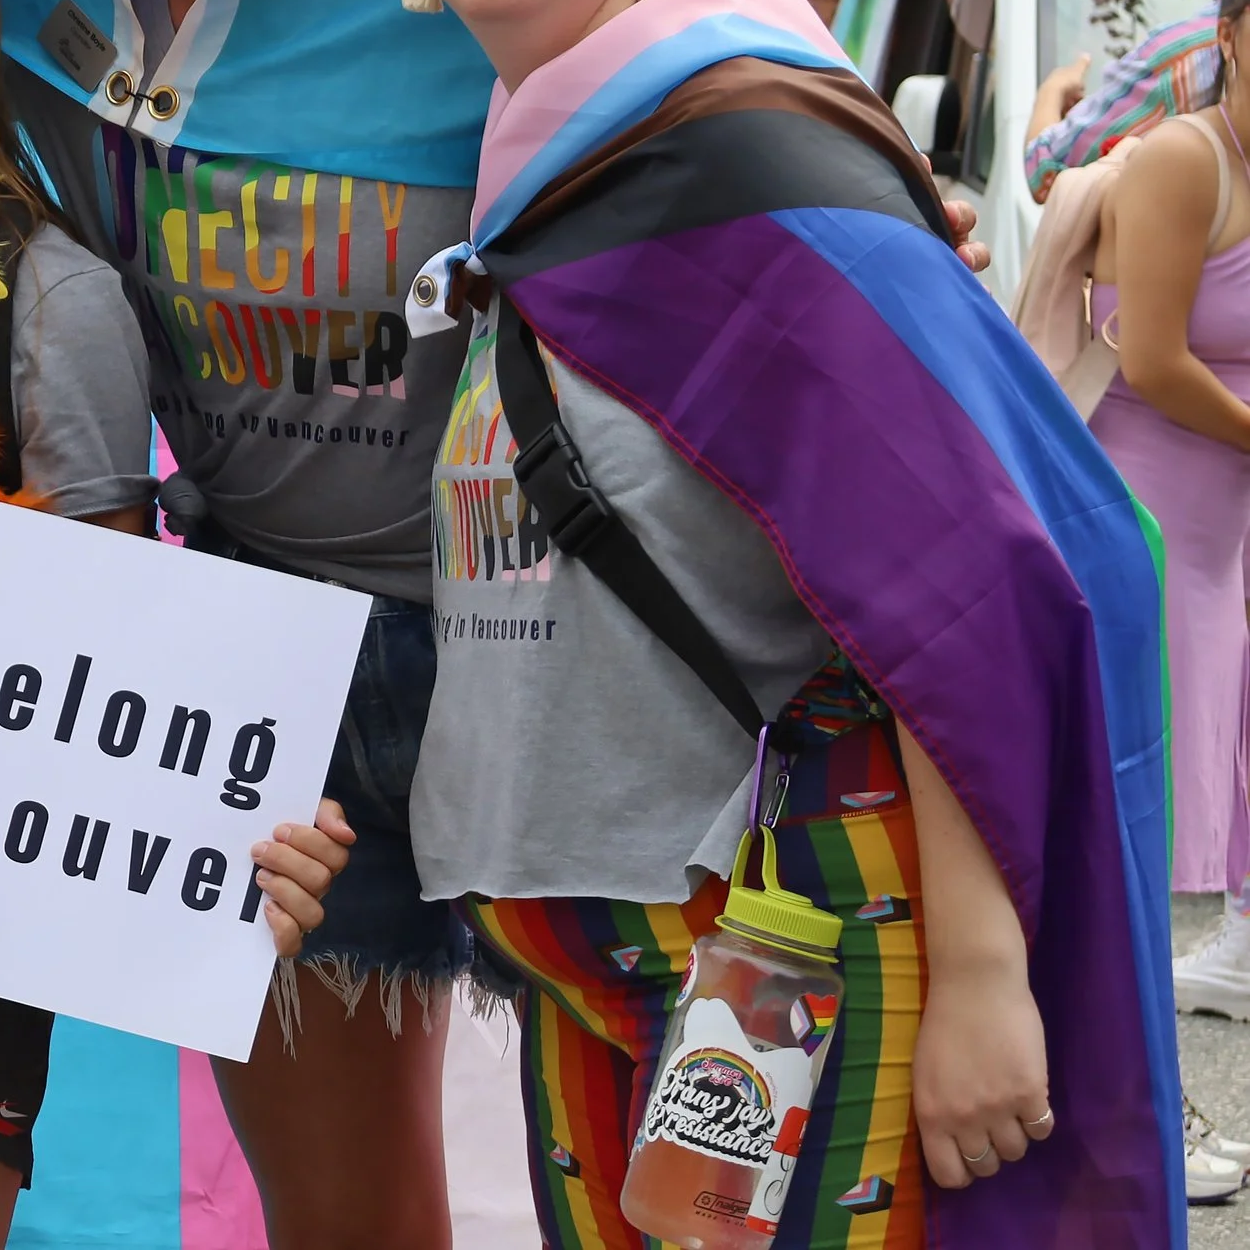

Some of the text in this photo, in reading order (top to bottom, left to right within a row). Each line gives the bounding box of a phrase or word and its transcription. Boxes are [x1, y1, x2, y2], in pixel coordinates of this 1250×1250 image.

[266, 415, 410, 448] Vancouver
[471, 612, 556, 641] Vancouver
[661, 1067, 731, 1119] Trans
[722, 1098, 773, 1131] joy
[666, 1111, 776, 1159] resistance
